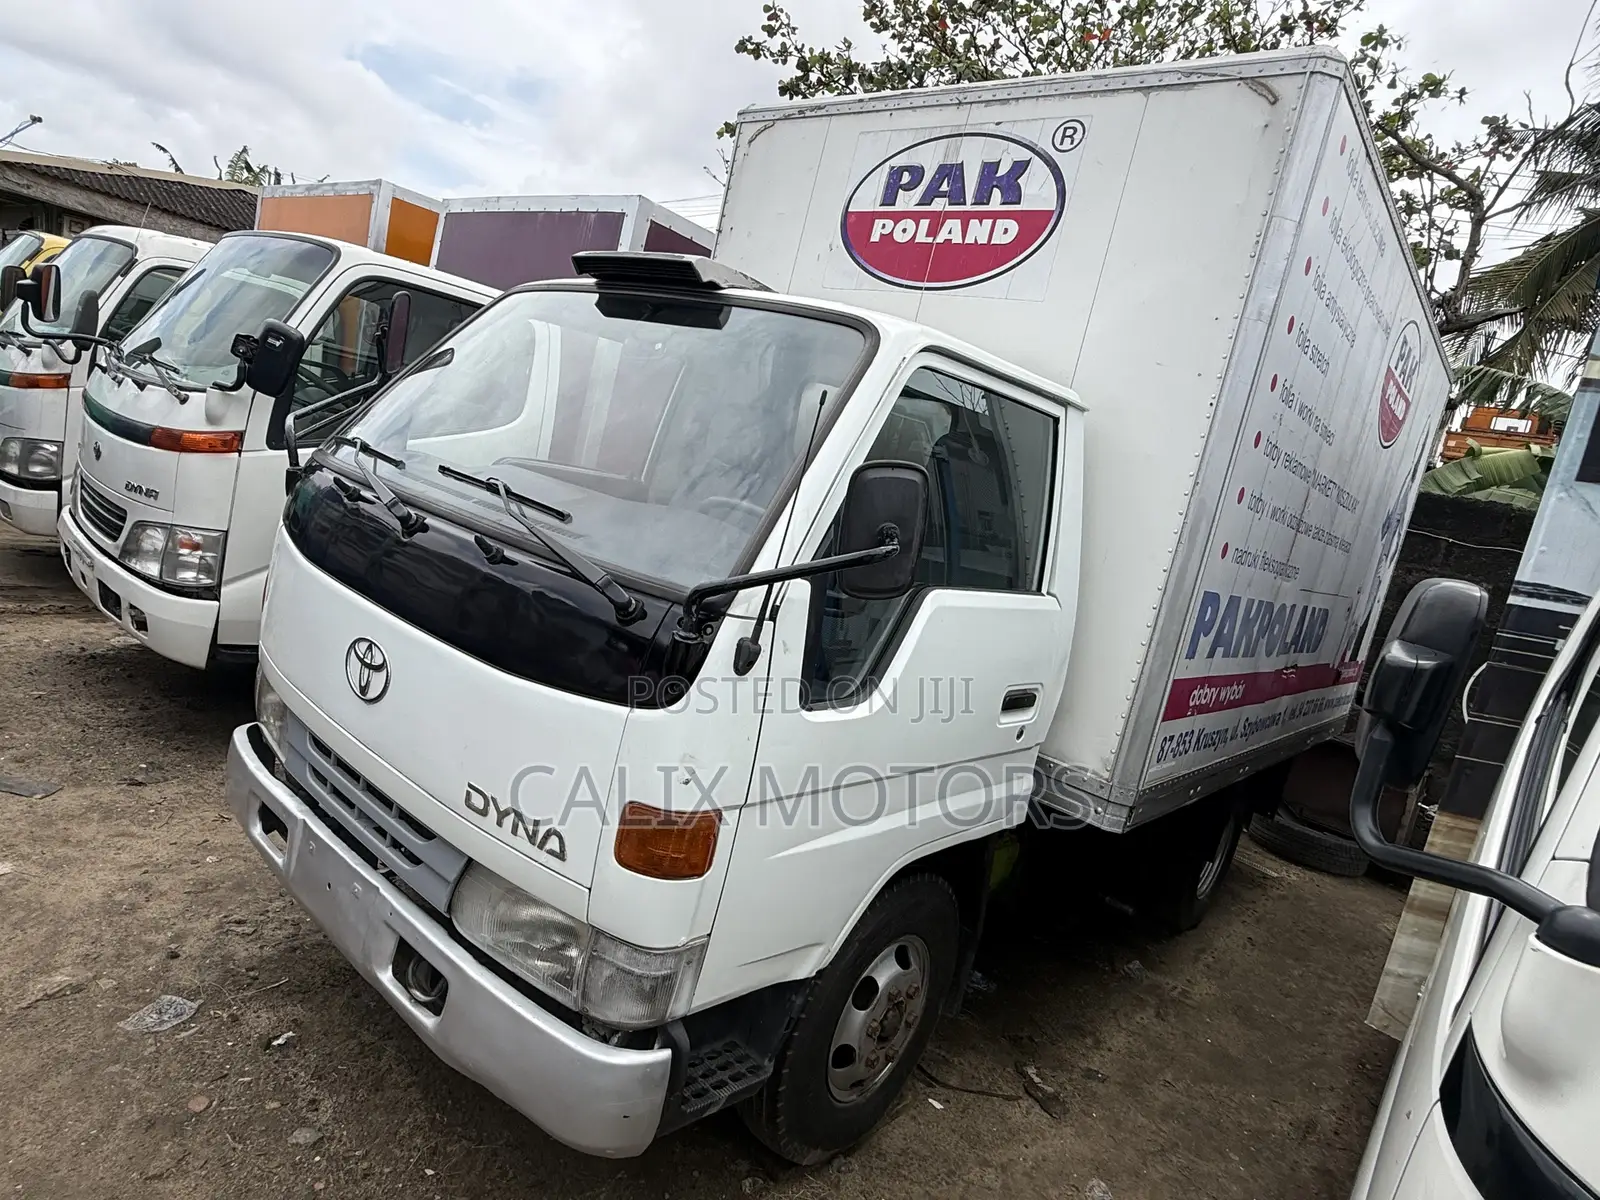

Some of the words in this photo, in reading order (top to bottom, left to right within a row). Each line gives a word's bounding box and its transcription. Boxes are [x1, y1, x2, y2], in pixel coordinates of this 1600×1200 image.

[879, 157, 1032, 207] PAK
[870, 218, 1019, 245] POLAND
[1329, 206, 1343, 245] folia
[1312, 265, 1326, 300] folia
[1295, 321, 1311, 356] folia
[1310, 339, 1330, 377] stretch
[1394, 334, 1418, 394] PAK
[1279, 378, 1295, 411] folia
[1298, 397, 1316, 427] worki
[1263, 435, 1283, 468] torby
[1282, 449, 1311, 481] reklamowe
[124, 481, 159, 500] DYNA
[1247, 491, 1267, 520] torby
[1271, 502, 1289, 524] worki
[1231, 545, 1260, 569] nadruki
[1185, 590, 1329, 659] PAKPOLAND
[1190, 682, 1219, 707] dobry
[1220, 680, 1246, 702] wybór
[1156, 730, 1194, 763] 87-853
[464, 781, 567, 862] DYNA
